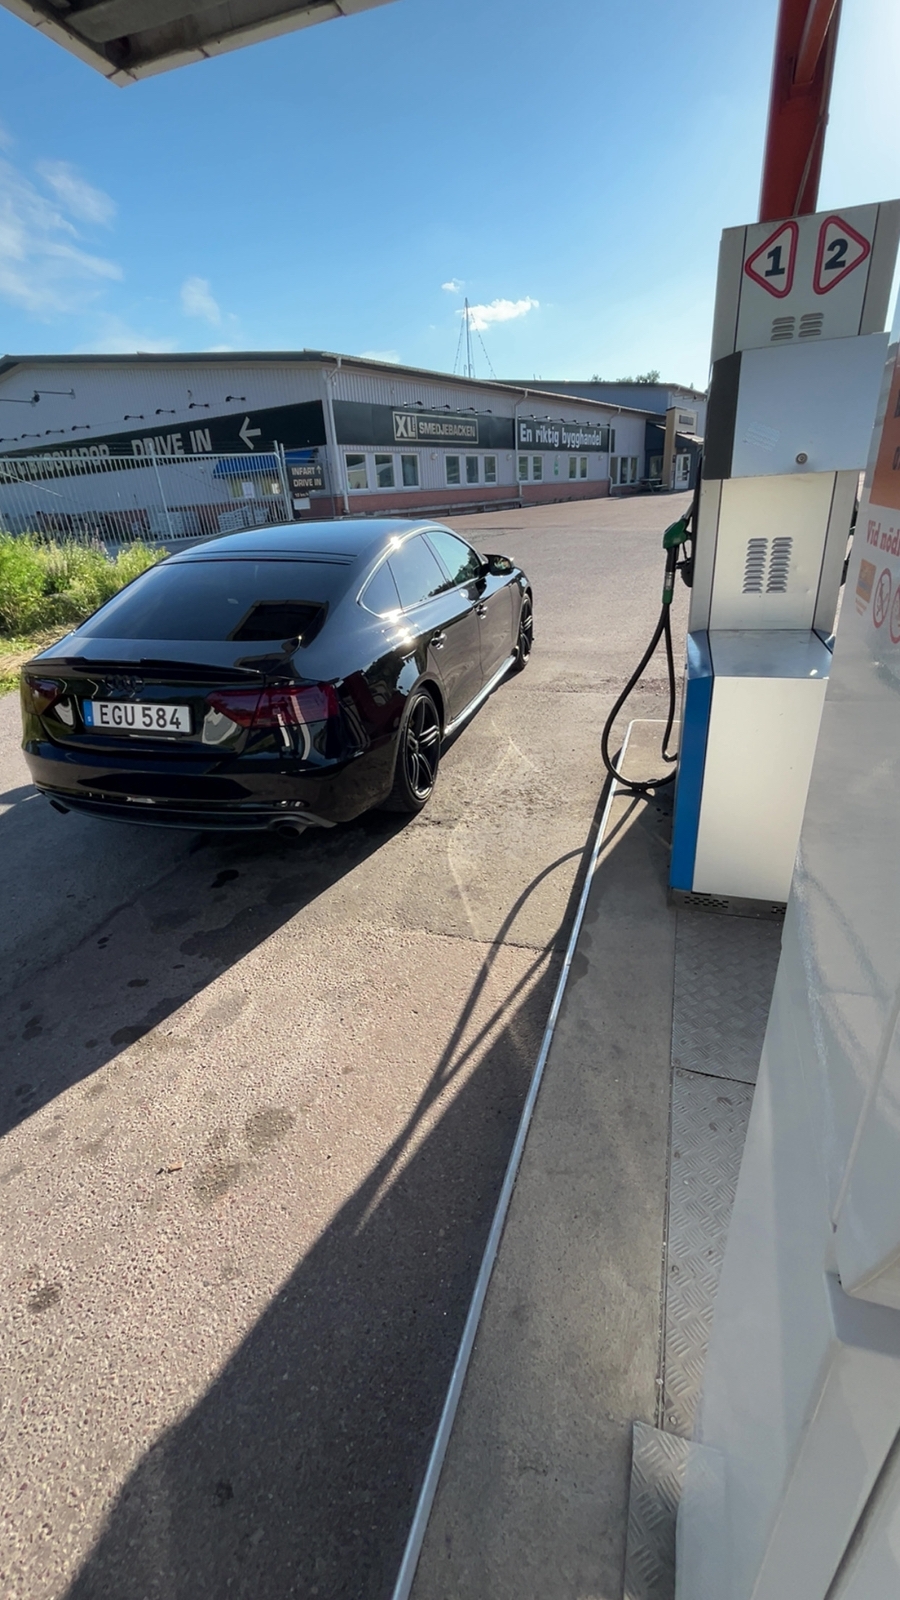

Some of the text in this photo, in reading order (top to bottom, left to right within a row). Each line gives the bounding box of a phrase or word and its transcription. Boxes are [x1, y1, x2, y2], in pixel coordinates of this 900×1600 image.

[764, 245, 785, 278] 1
[824, 238, 849, 271] 2
[419, 421, 476, 438] SMEDJEBACKEN
[520, 423, 602, 449] En riktig bygghandel
[131, 433, 185, 460] DRIVE
[189, 427, 213, 453] IN
[291, 466, 315, 476] INFART
[293, 478, 322, 487] DRIVE IN
[866, 519, 881, 547] Vid
[99, 703, 182, 730] EGU 584
